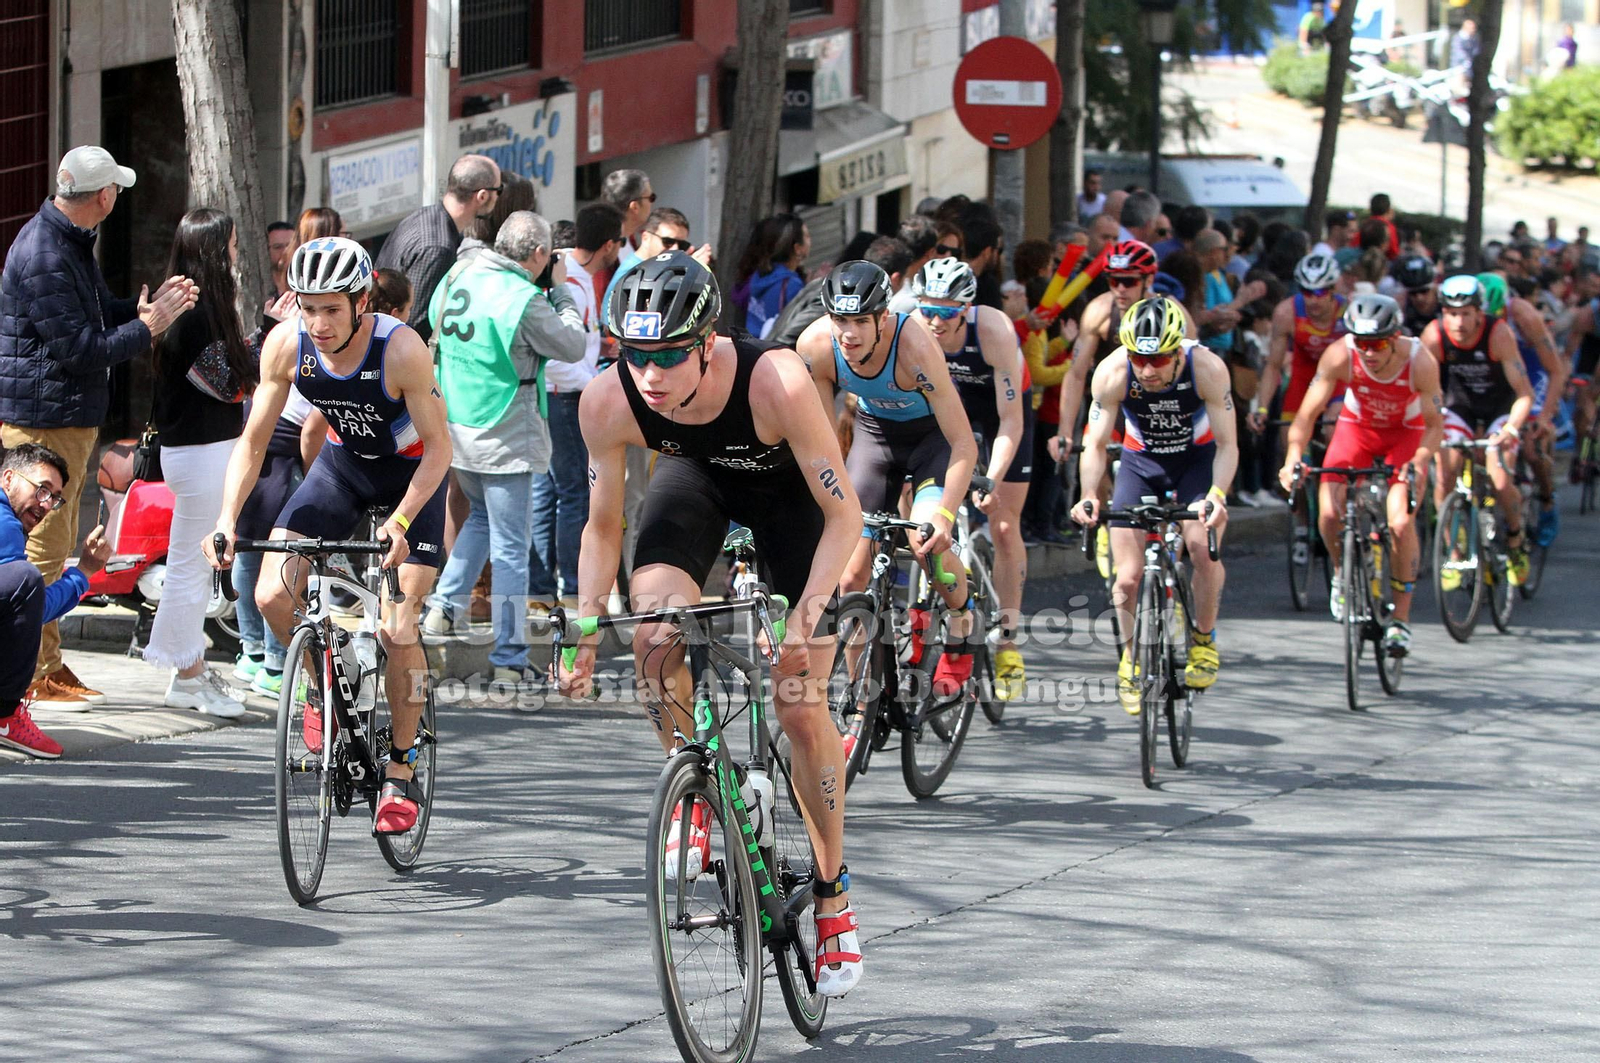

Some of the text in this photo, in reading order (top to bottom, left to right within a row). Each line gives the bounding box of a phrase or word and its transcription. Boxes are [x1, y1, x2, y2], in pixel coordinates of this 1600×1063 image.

[837, 297, 859, 311] 49
[626, 316, 657, 336] 21
[339, 418, 376, 438] FRA
[819, 468, 845, 501] 21
[329, 631, 367, 742] SCOTT
